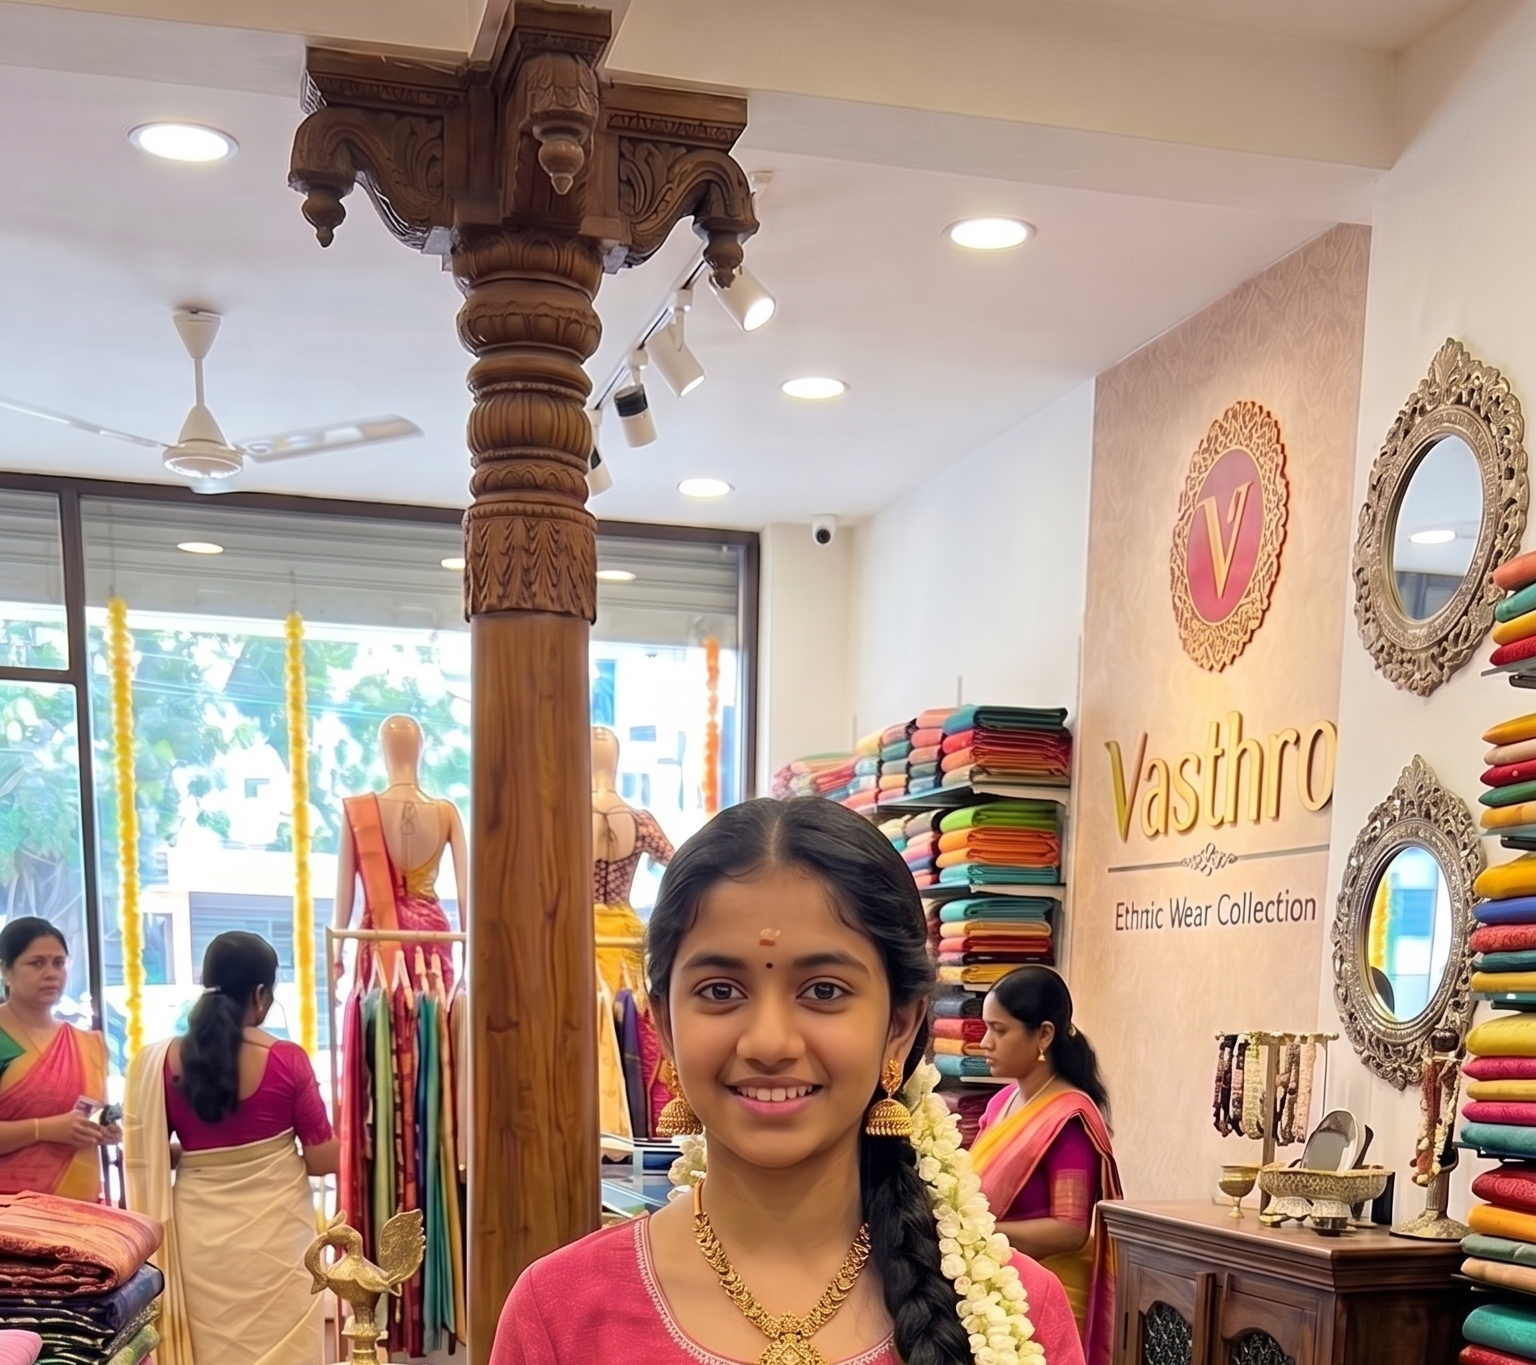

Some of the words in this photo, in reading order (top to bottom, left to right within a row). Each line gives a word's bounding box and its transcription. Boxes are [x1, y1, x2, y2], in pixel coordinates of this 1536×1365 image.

[1195, 481, 1254, 599] V
[1104, 710, 1337, 843] Vasthro
[1115, 901, 1163, 931] Ethnic
[1169, 896, 1212, 928] Wear
[1217, 889, 1316, 926] Collection
